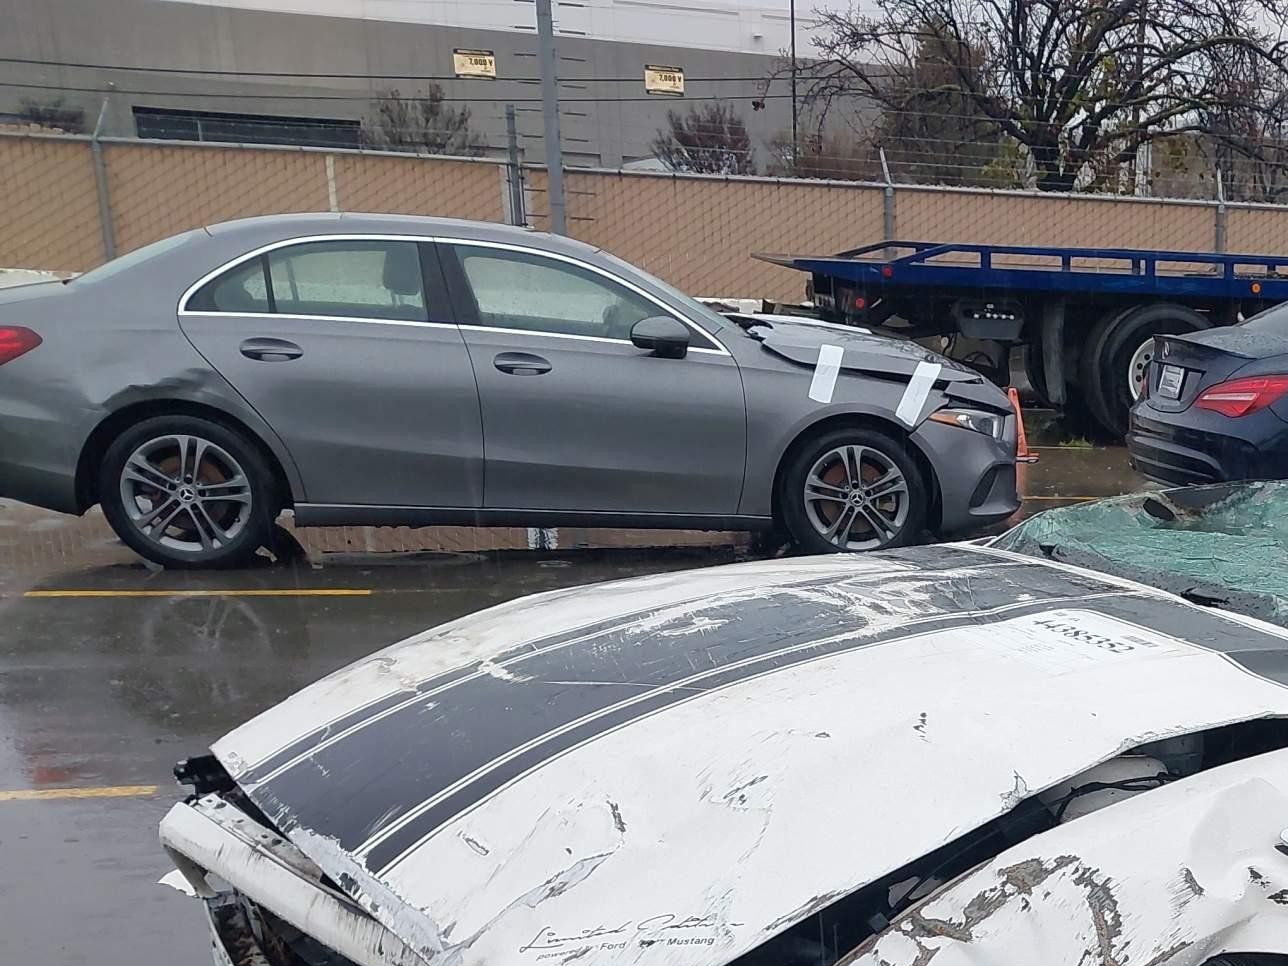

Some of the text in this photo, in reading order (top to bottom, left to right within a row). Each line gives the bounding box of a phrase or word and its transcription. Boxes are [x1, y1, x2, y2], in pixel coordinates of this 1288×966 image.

[519, 913, 745, 954] Limited Editin
[599, 940, 628, 951] Ford
[666, 937, 715, 946] Mustang
